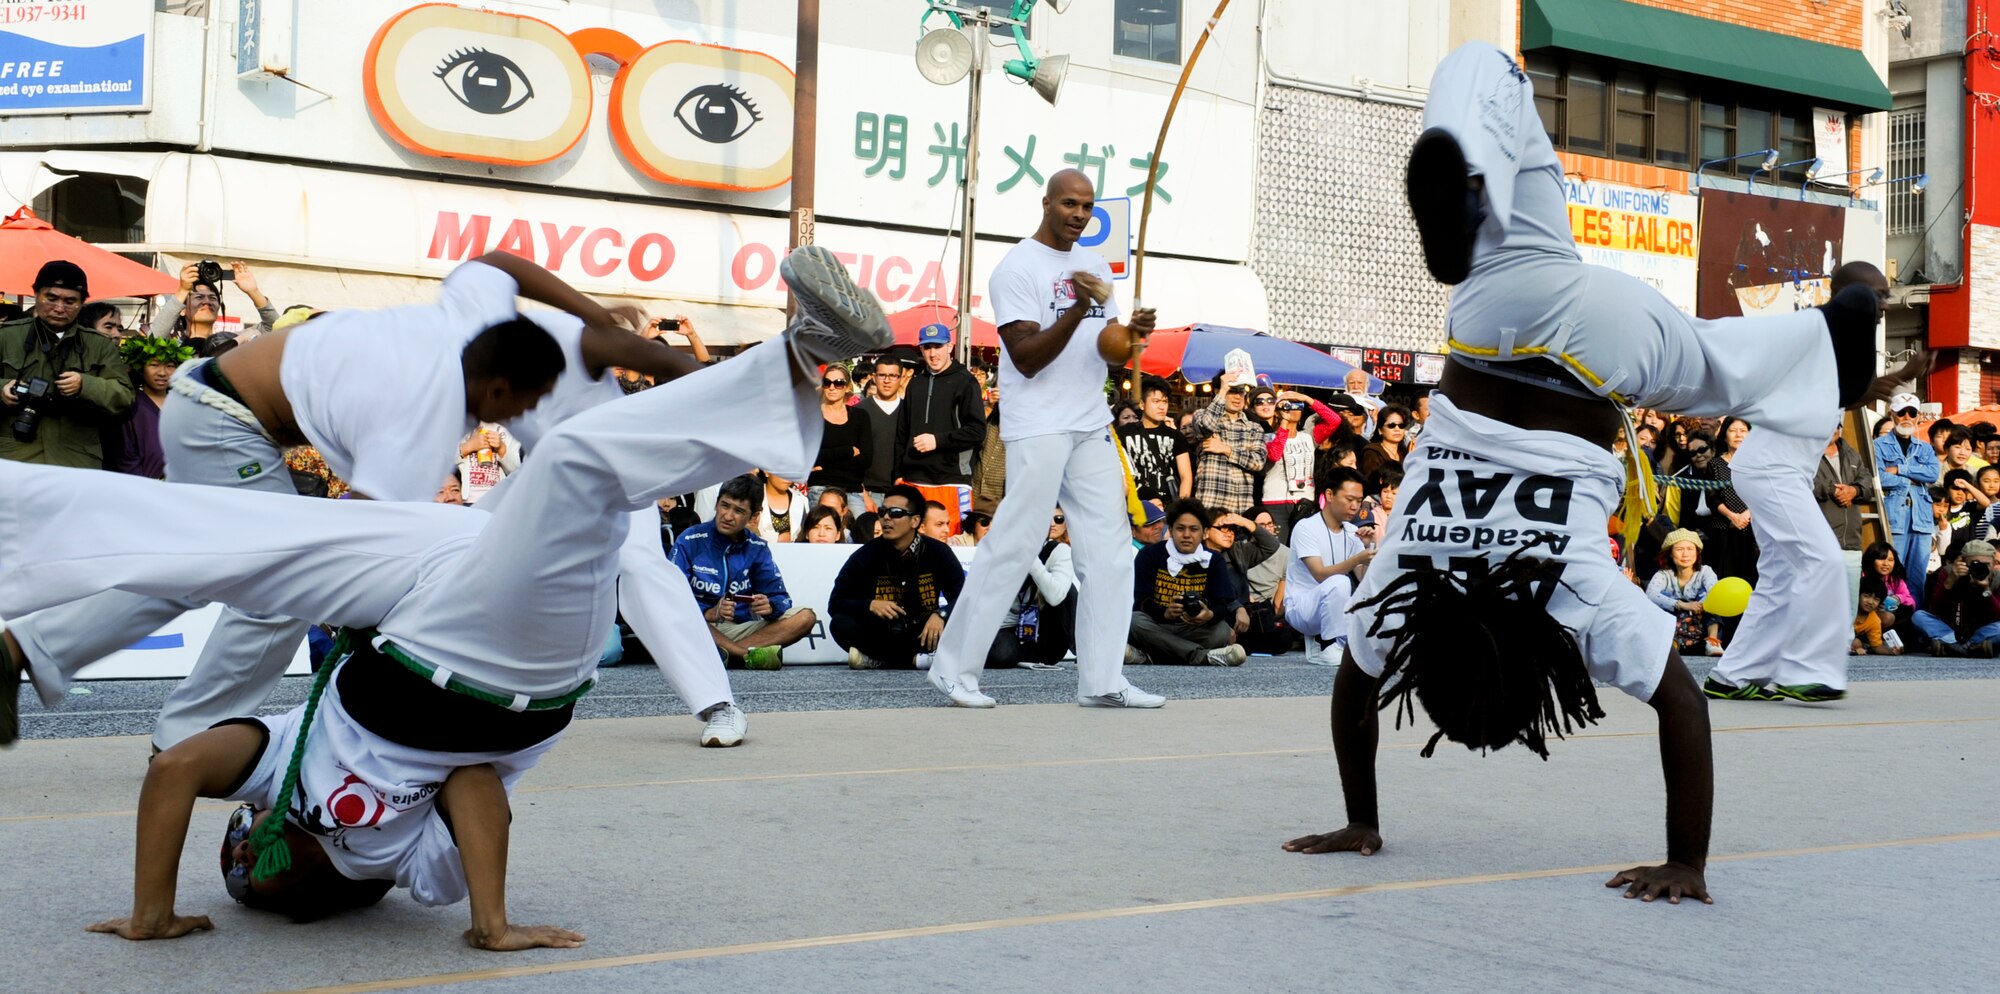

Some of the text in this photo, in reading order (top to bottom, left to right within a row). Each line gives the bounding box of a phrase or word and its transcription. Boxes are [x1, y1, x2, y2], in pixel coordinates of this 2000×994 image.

[0, 60, 64, 79] FREE
[21, 84, 44, 98] eye
[47, 79, 132, 95] examination!
[1603, 189, 1669, 215] UNIFORMS
[427, 210, 676, 282] MAYCO
[1621, 214, 1693, 257] TAILOR
[1364, 350, 1380, 364] ICE
[1383, 351, 1411, 367] COLD
[1373, 366, 1402, 381] BEER
[1403, 468, 1575, 526] DAY
[1401, 517, 1571, 556] Academy
